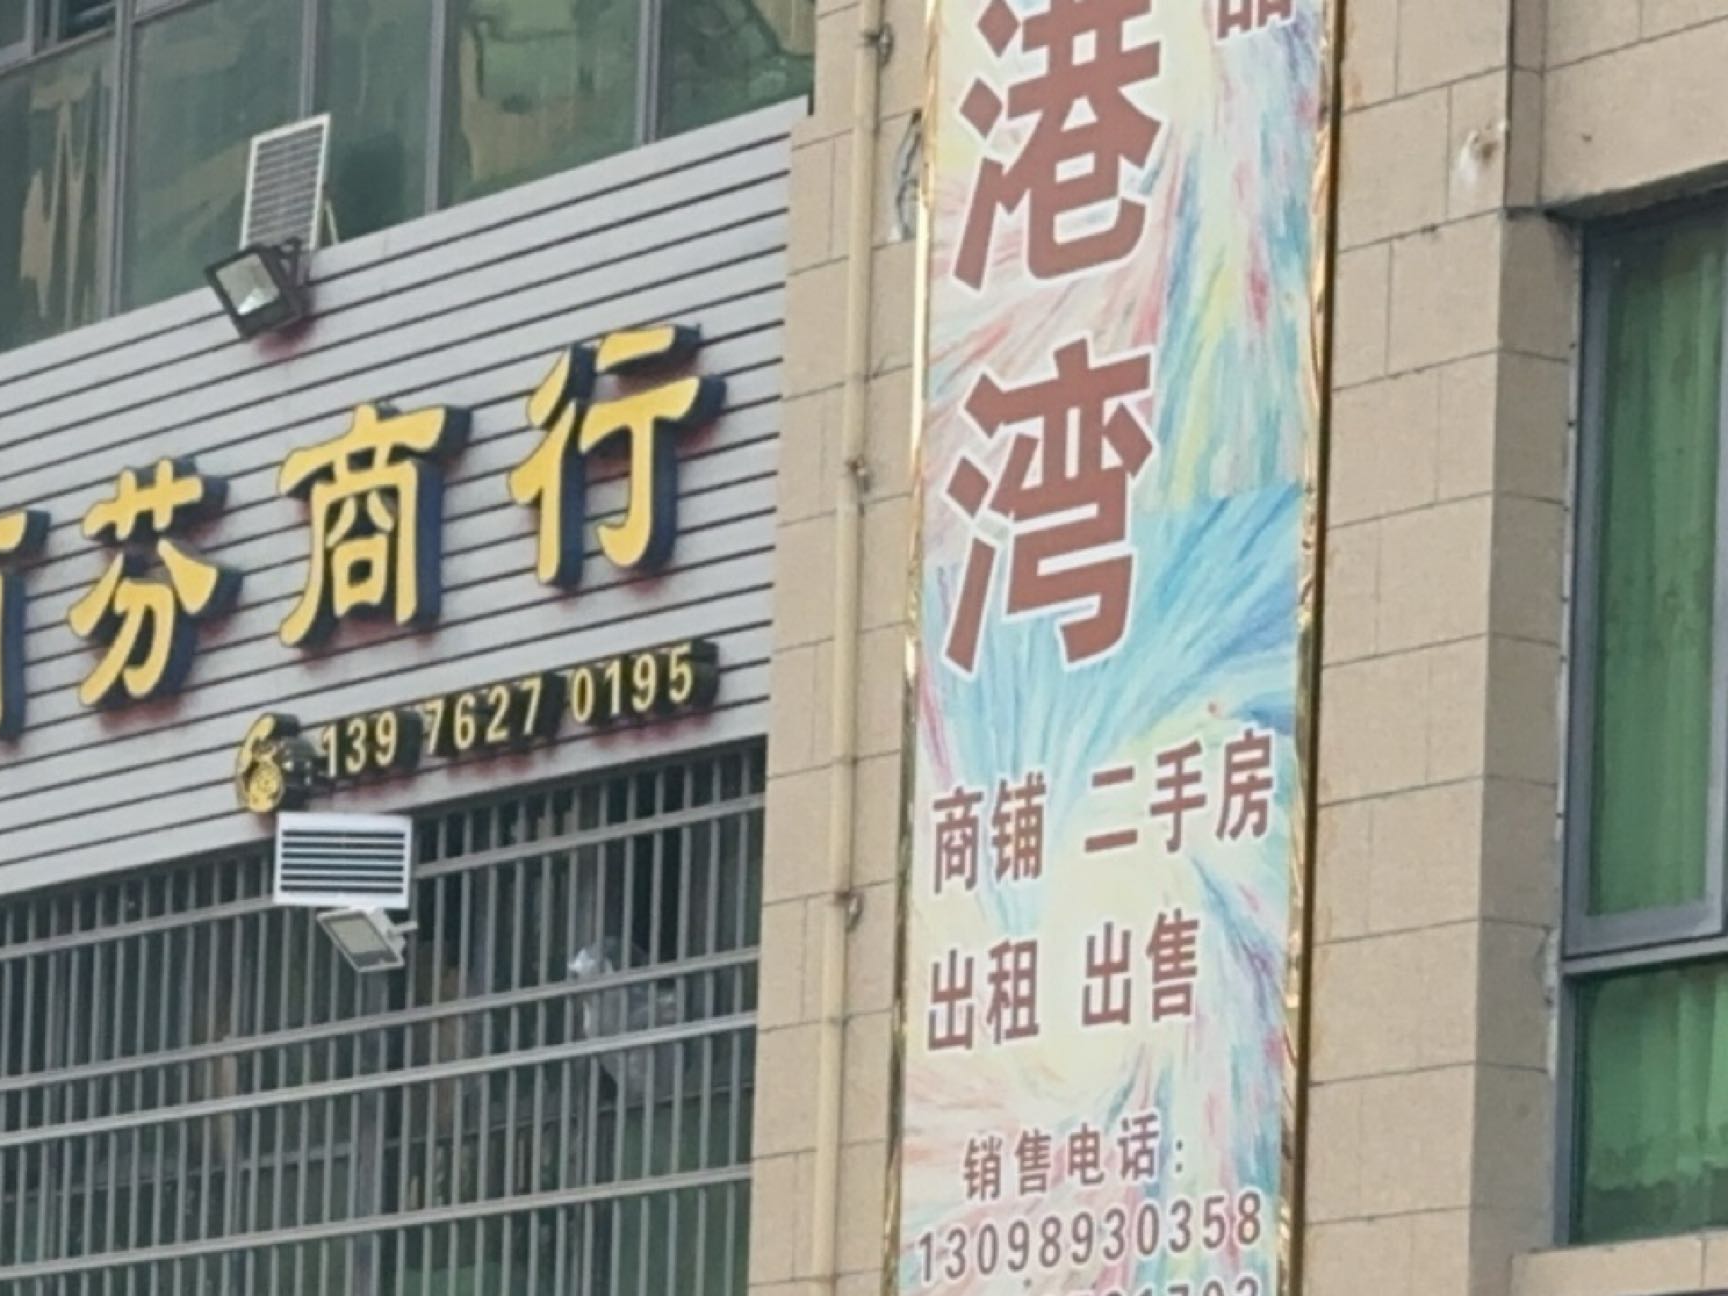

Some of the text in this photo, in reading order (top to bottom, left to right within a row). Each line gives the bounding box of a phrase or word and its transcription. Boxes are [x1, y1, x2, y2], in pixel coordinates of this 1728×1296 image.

[320, 648, 694, 778] 139 7627 0195
[932, 728, 1275, 895] 商铺 二手房
[927, 908, 1200, 1052] 出租 出售
[918, 1190, 1262, 1282] 13098930358
